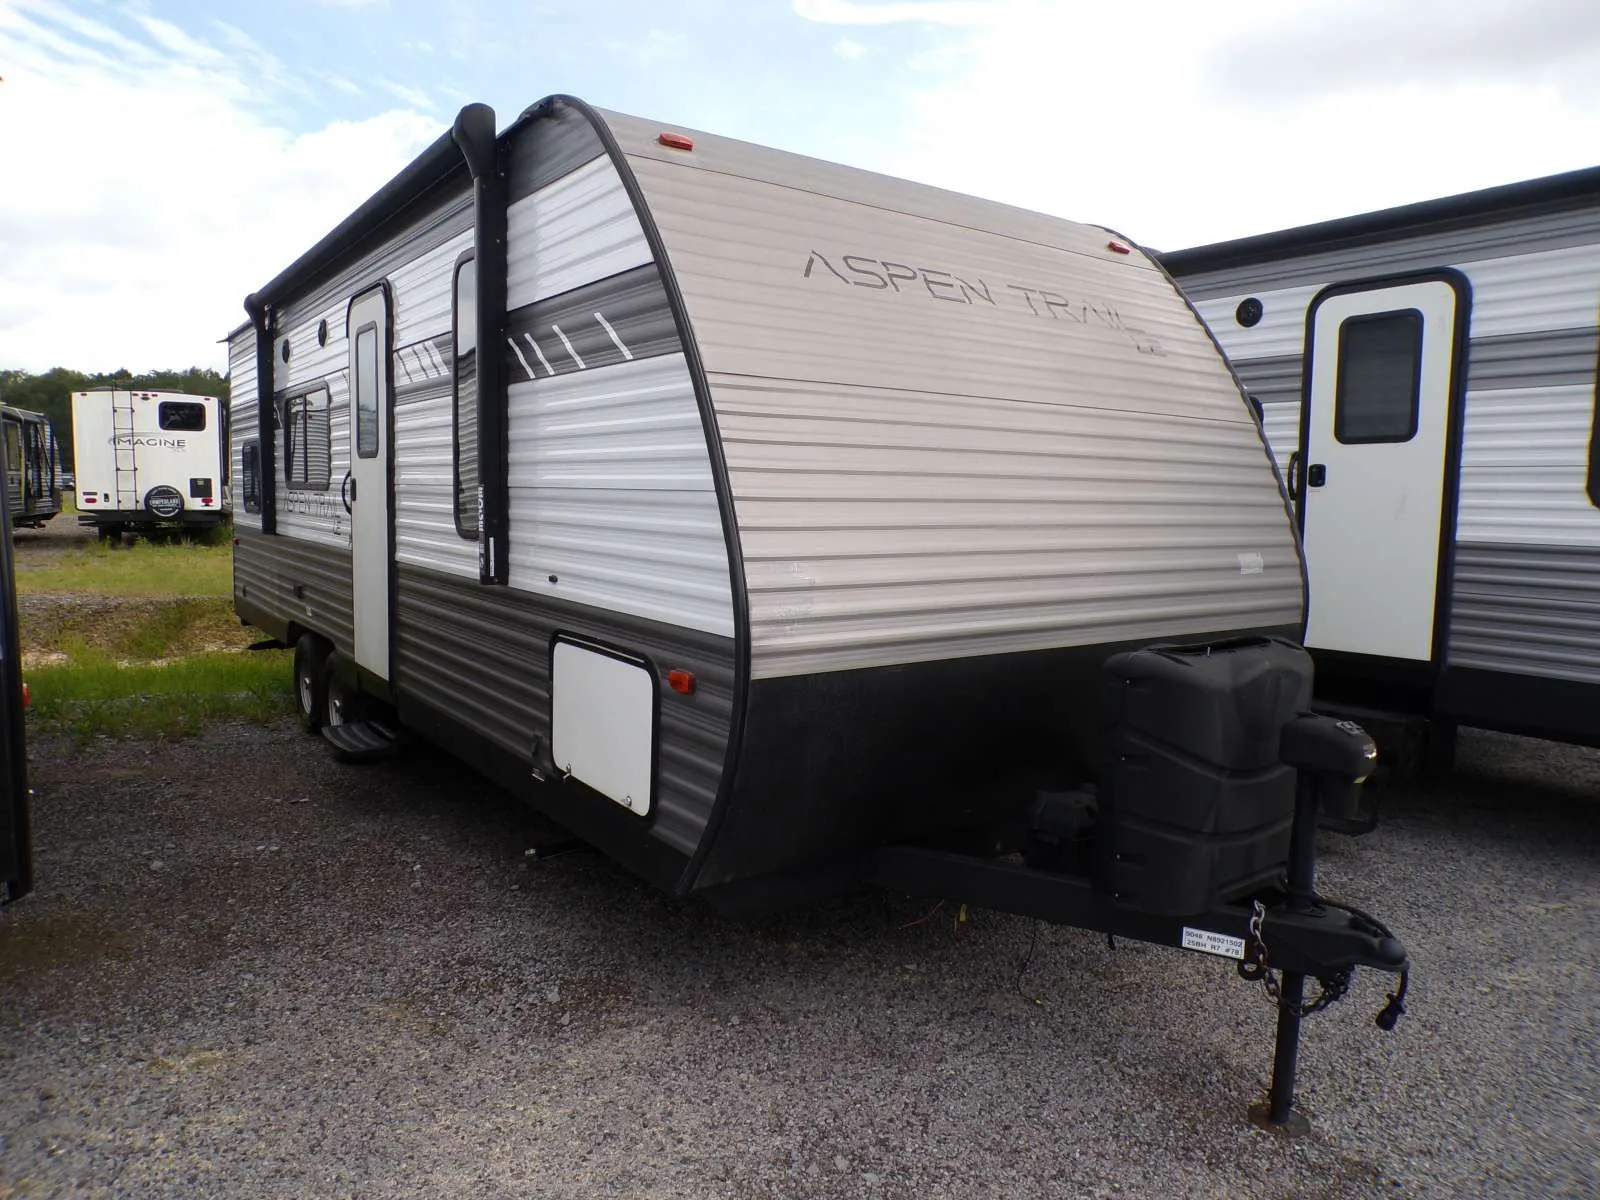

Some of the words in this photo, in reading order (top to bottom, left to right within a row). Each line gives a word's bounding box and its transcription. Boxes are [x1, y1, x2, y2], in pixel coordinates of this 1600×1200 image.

[804, 250, 996, 305] ASPEN
[1006, 284, 1147, 333] TRAIL
[113, 438, 186, 447] IMAGINE
